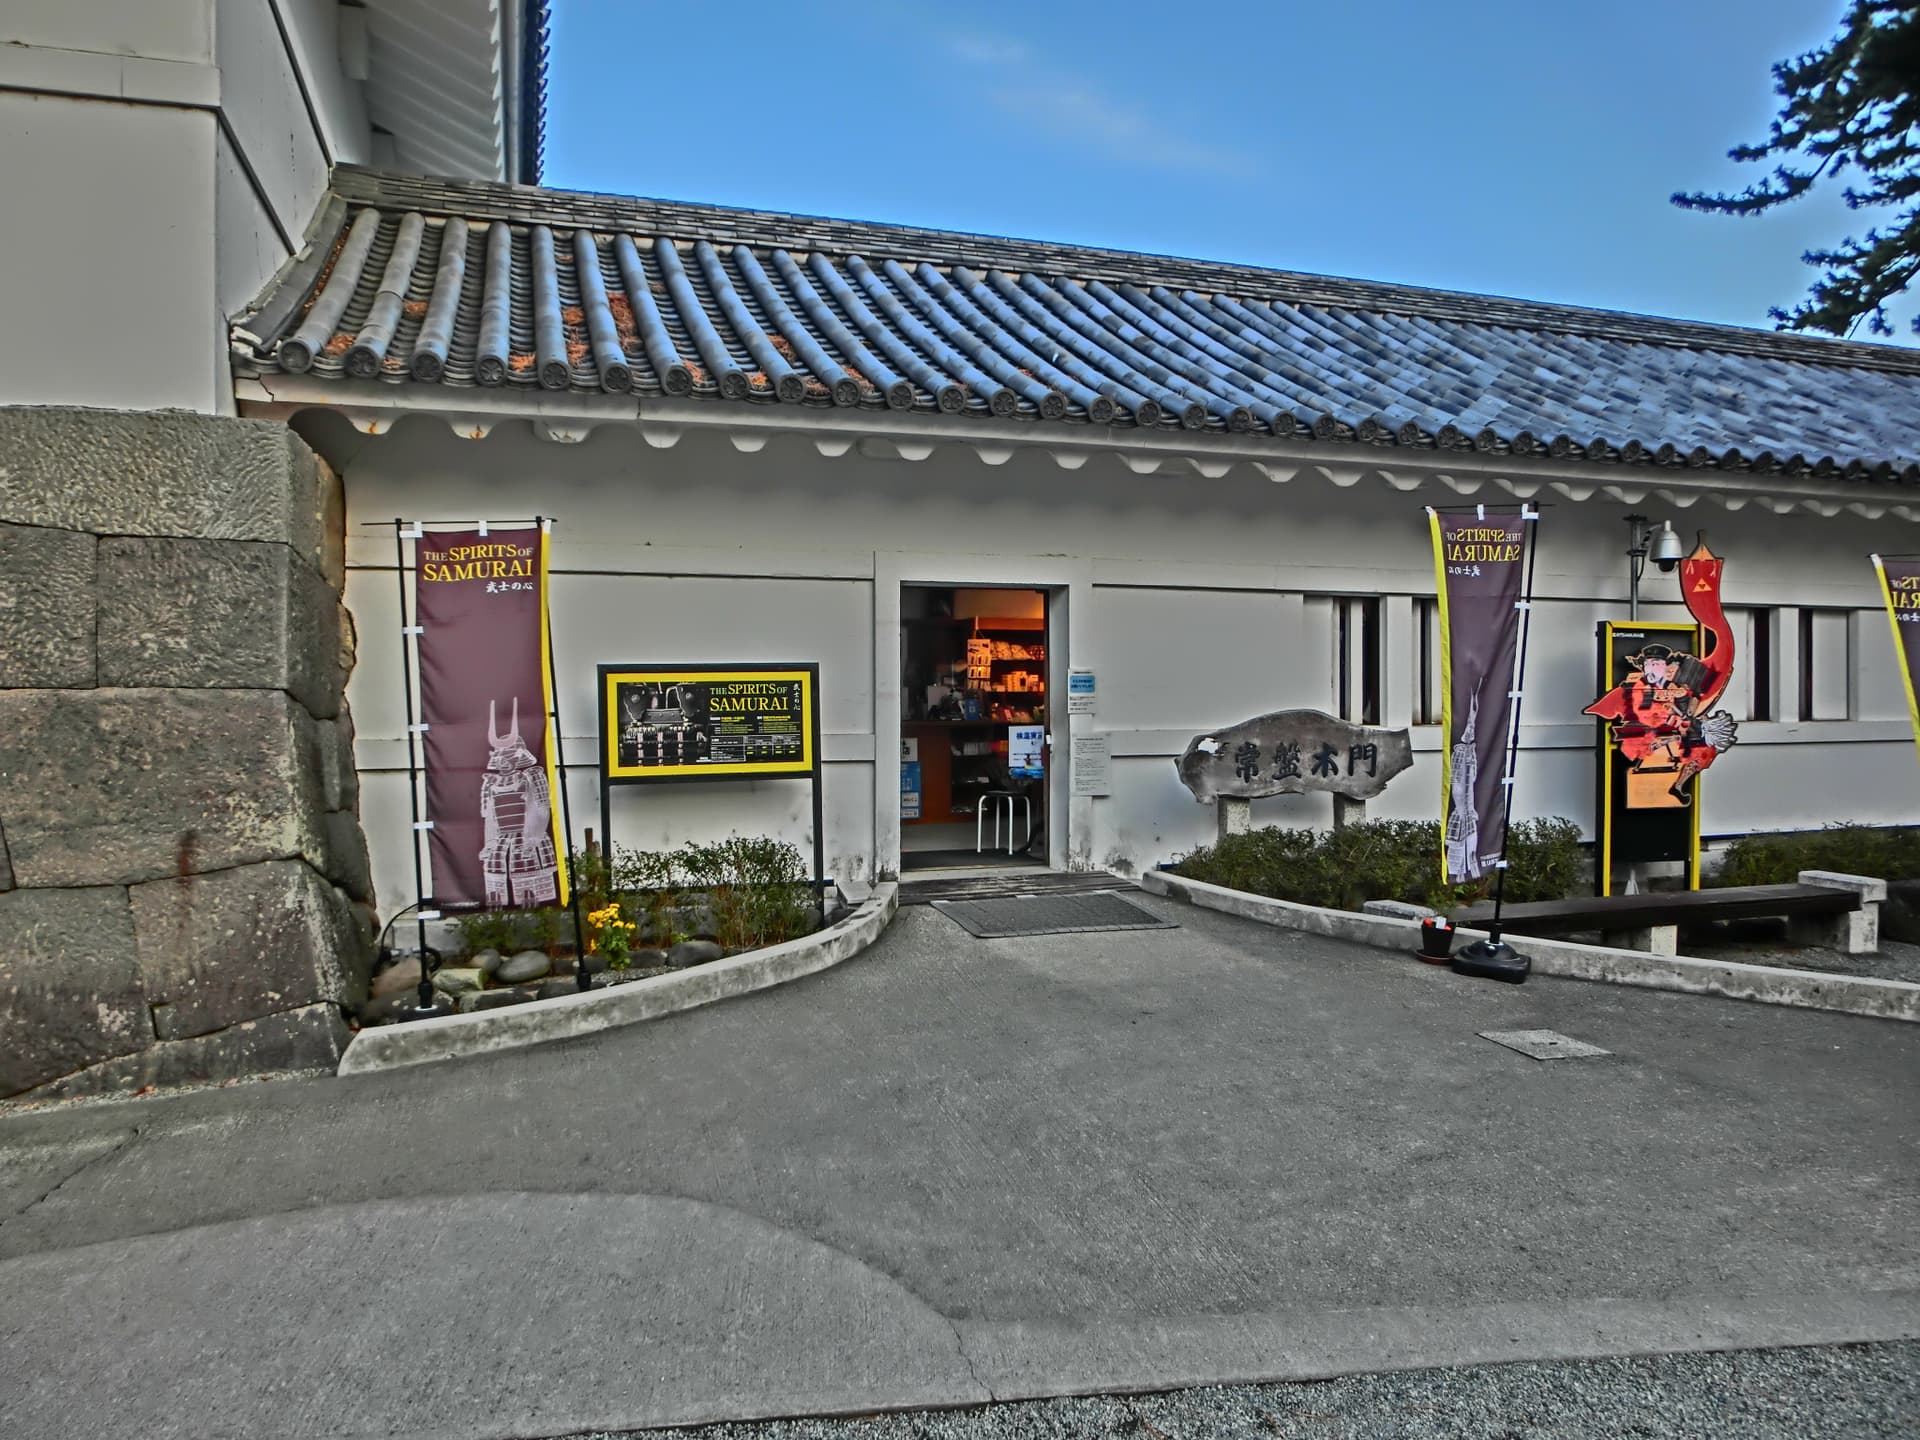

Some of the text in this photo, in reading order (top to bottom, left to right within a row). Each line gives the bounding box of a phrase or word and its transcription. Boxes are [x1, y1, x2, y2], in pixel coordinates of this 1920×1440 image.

[423, 544, 534, 562] THE SPIRITS OF
[423, 559, 533, 582] SAMURAI
[485, 581, 534, 594] 武士の心
[709, 683, 788, 695] THE SPIRITS OF
[709, 697, 788, 712] SAMURAI
[1235, 740, 1378, 783] 常盤木門
